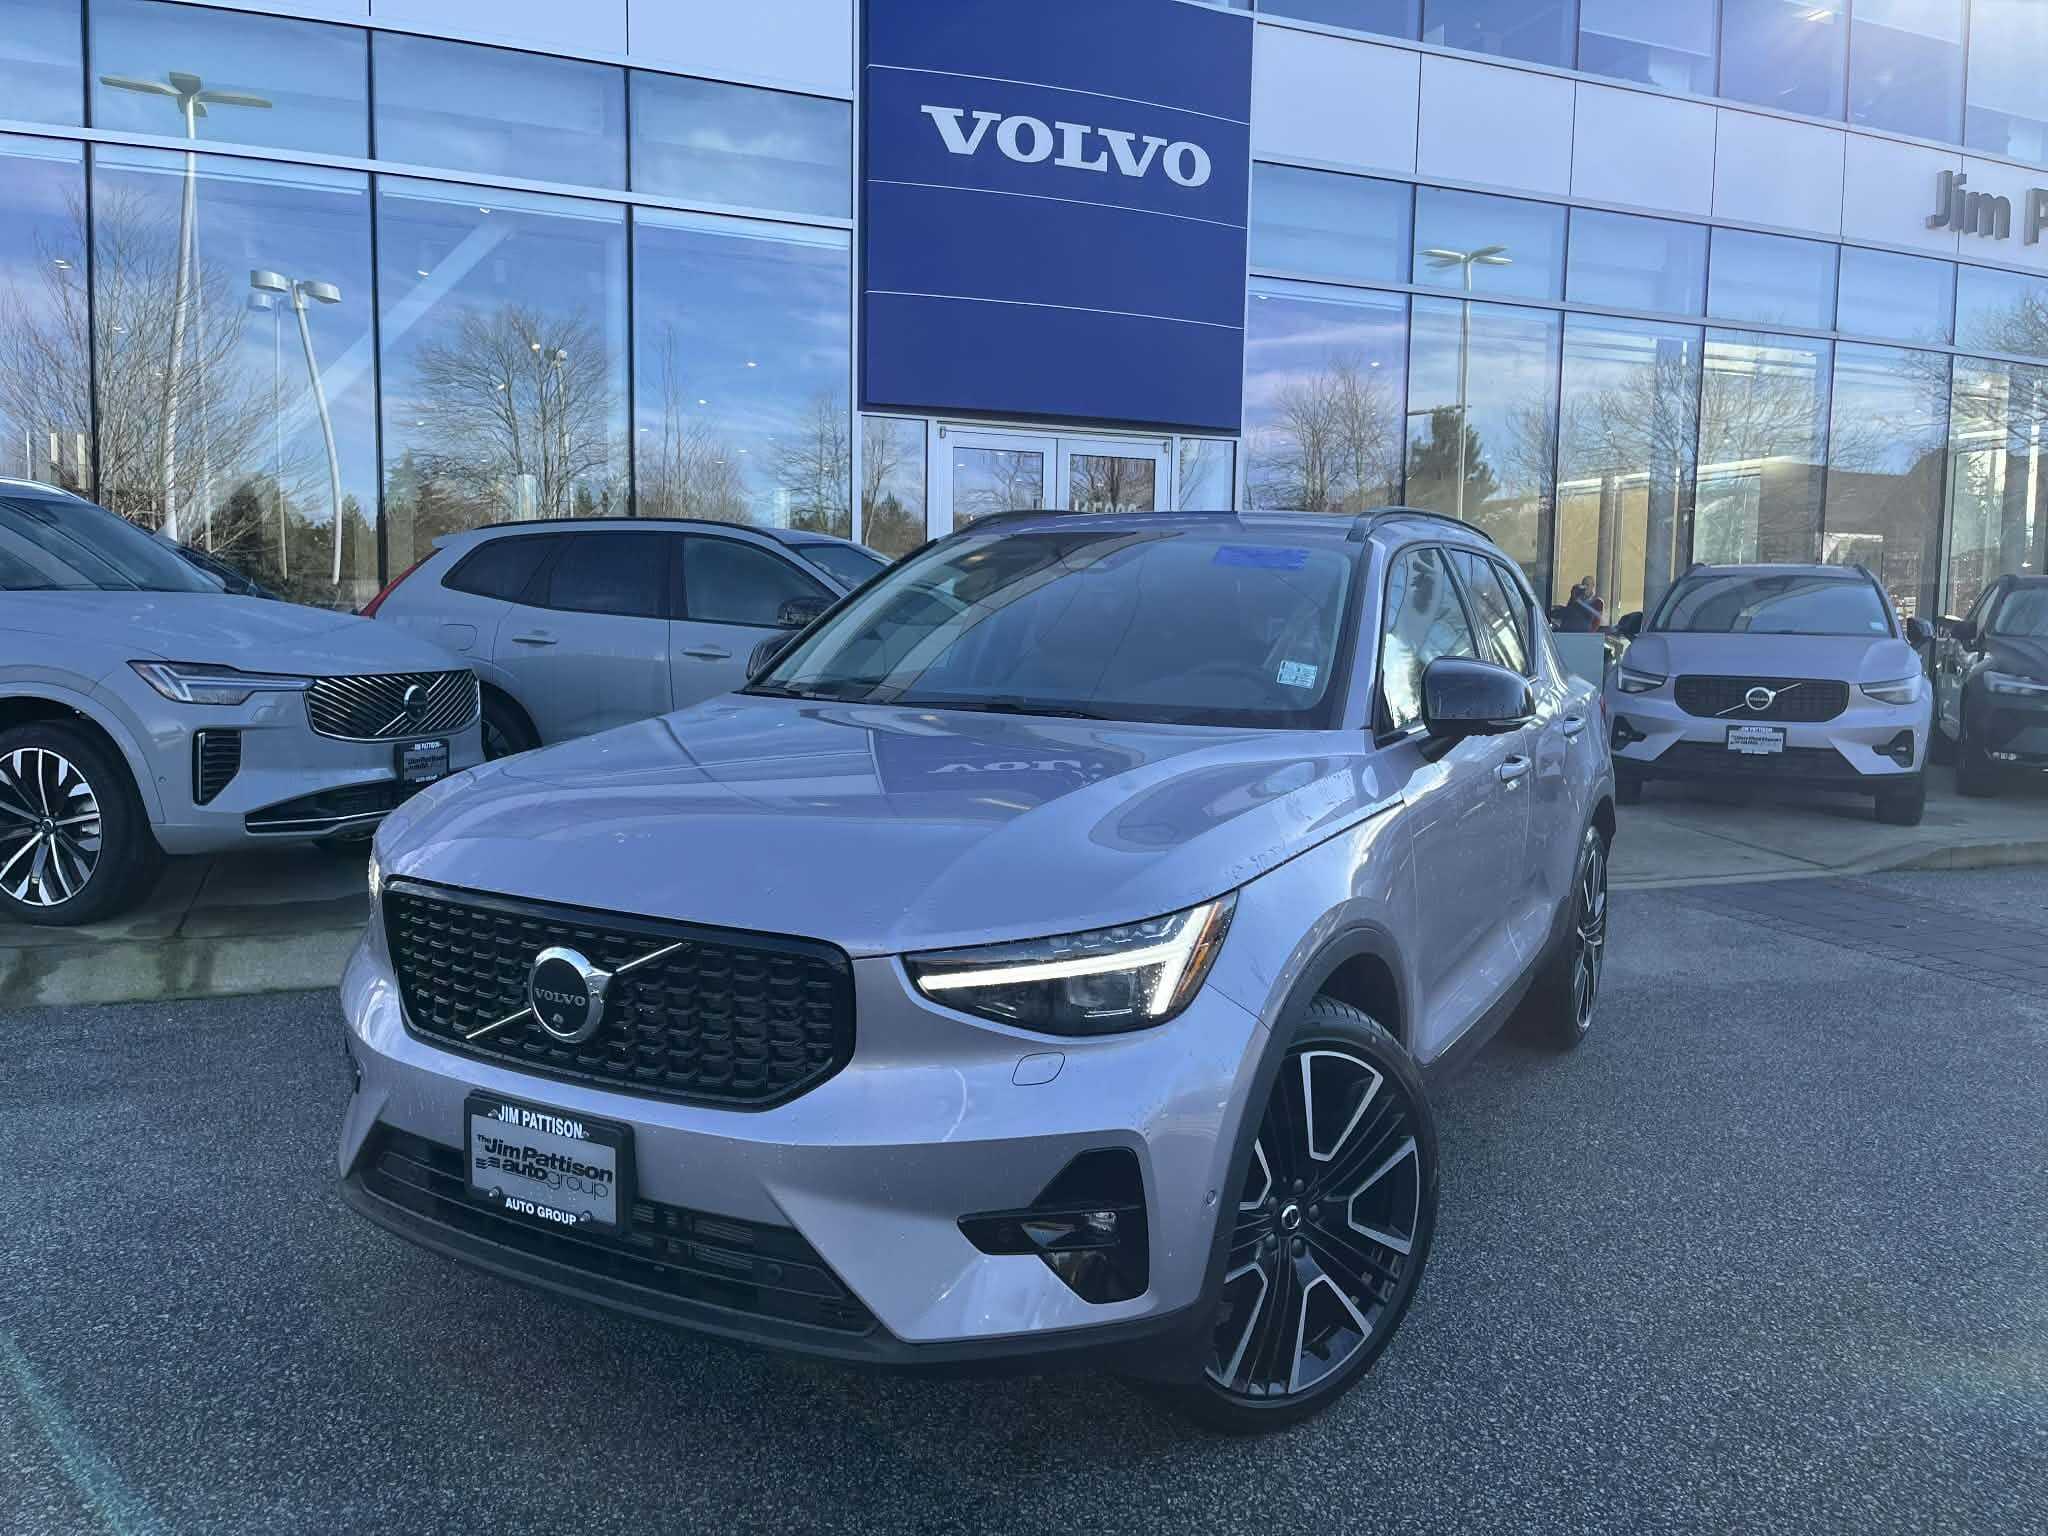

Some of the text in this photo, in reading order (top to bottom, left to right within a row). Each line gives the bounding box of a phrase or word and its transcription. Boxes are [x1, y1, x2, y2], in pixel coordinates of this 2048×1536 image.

[920, 104, 1212, 187] VOLVO
[1925, 169, 2011, 241] Jim
[535, 987, 586, 1007] VOLVO
[498, 1103, 584, 1139] JIM PATTISON
[505, 1197, 577, 1225] AUTO GROUP
